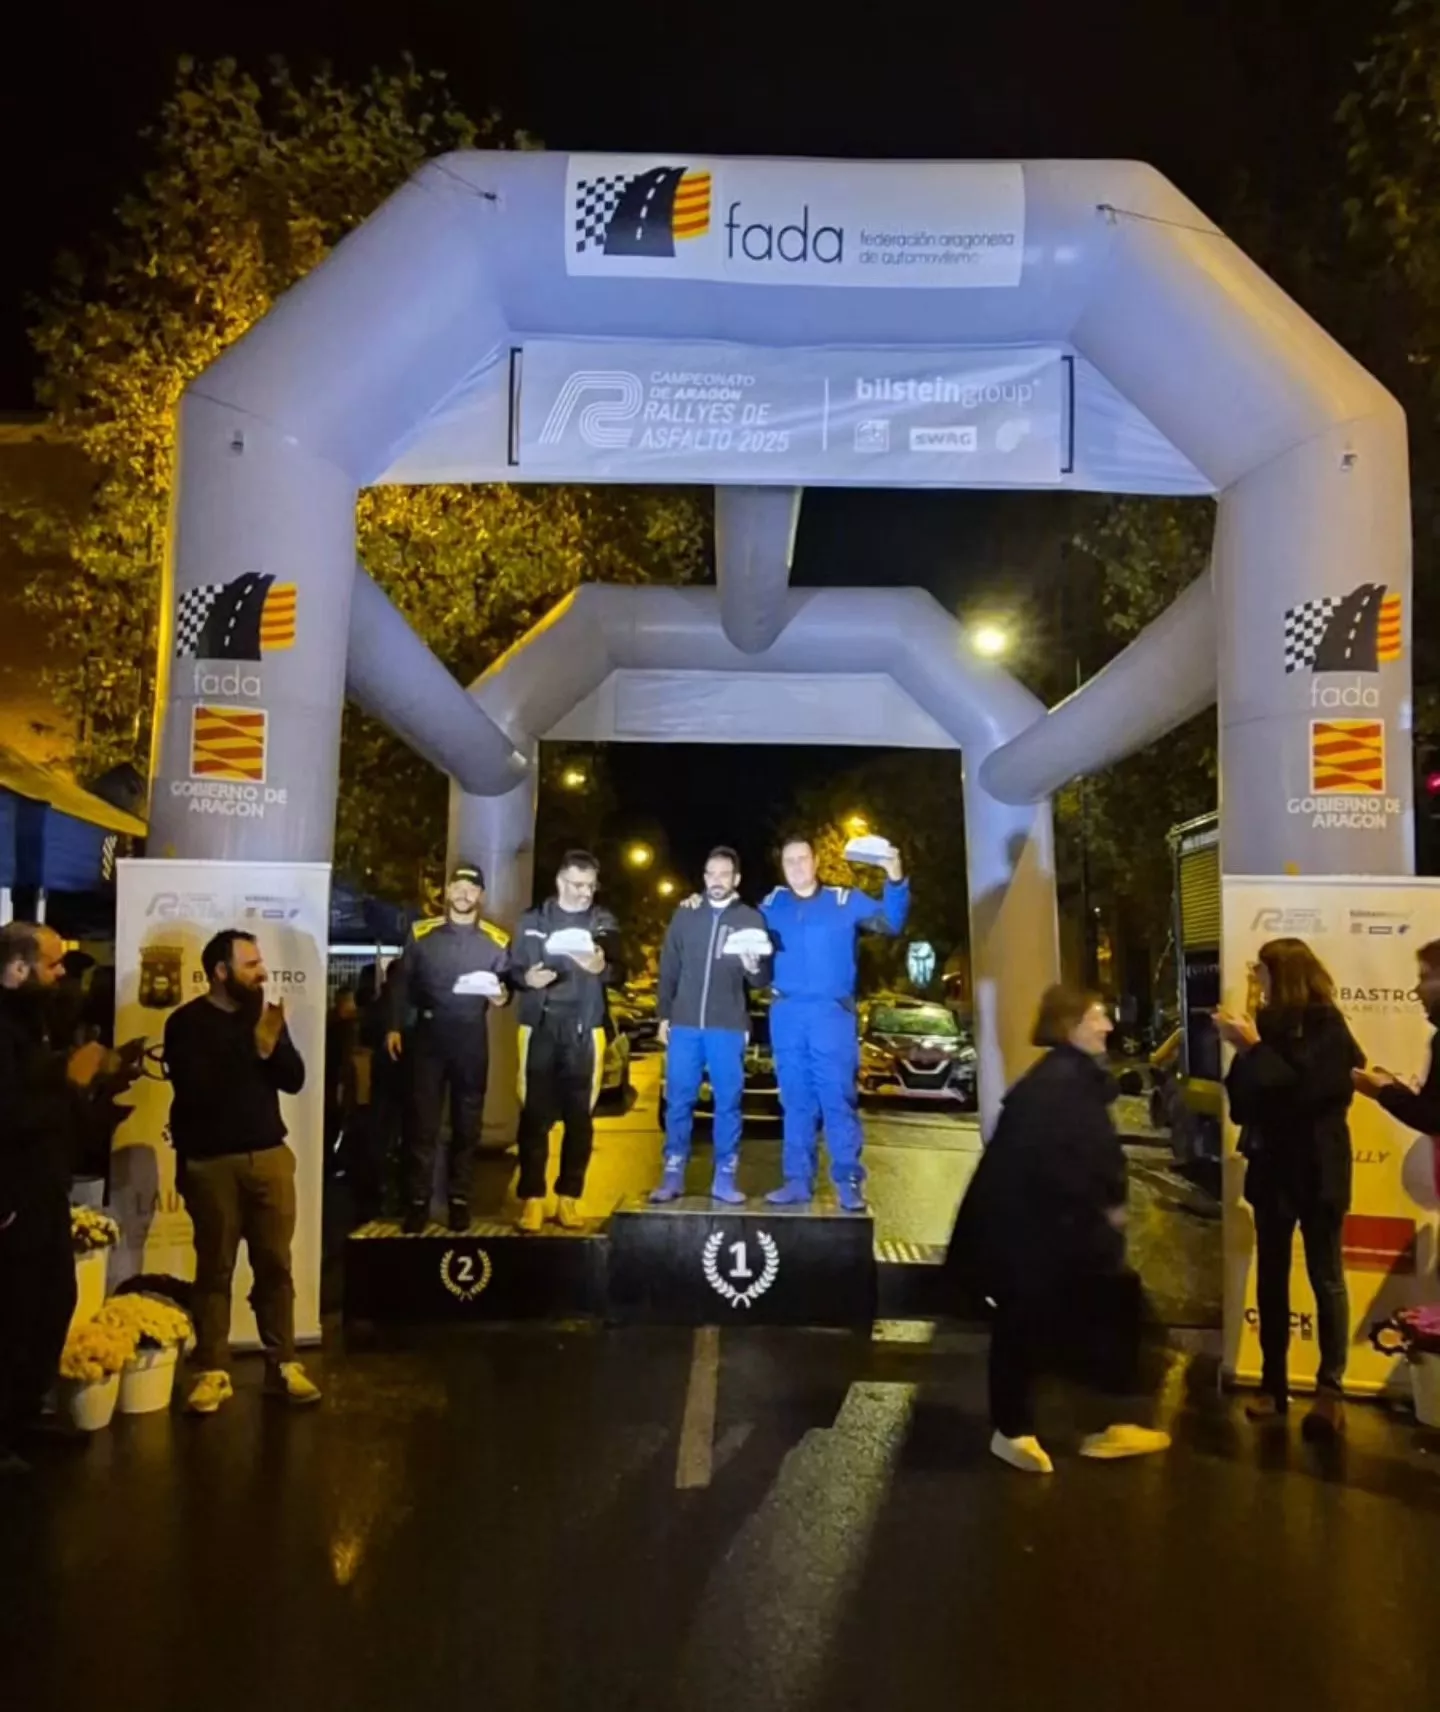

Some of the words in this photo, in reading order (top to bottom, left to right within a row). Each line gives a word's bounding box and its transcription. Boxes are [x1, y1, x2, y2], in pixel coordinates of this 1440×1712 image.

[724, 201, 844, 264] fada
[859, 251, 879, 264] de
[650, 371, 756, 388] CAMPEONATO
[649, 387, 670, 400] DE
[643, 402, 736, 425] RALLYES
[740, 403, 772, 426] DE
[638, 427, 732, 451] ASFALTO
[737, 429, 790, 453] 2025
[192, 662, 262, 696] fada
[1310, 676, 1380, 708] fada
[170, 780, 258, 802] GOBIERNO
[263, 787, 288, 804] DE
[1286, 797, 1380, 814] GOBIERNO
[1331, 986, 1420, 1002] BASTRO
[456, 1254, 475, 1281] 2
[728, 1240, 753, 1277] 1
